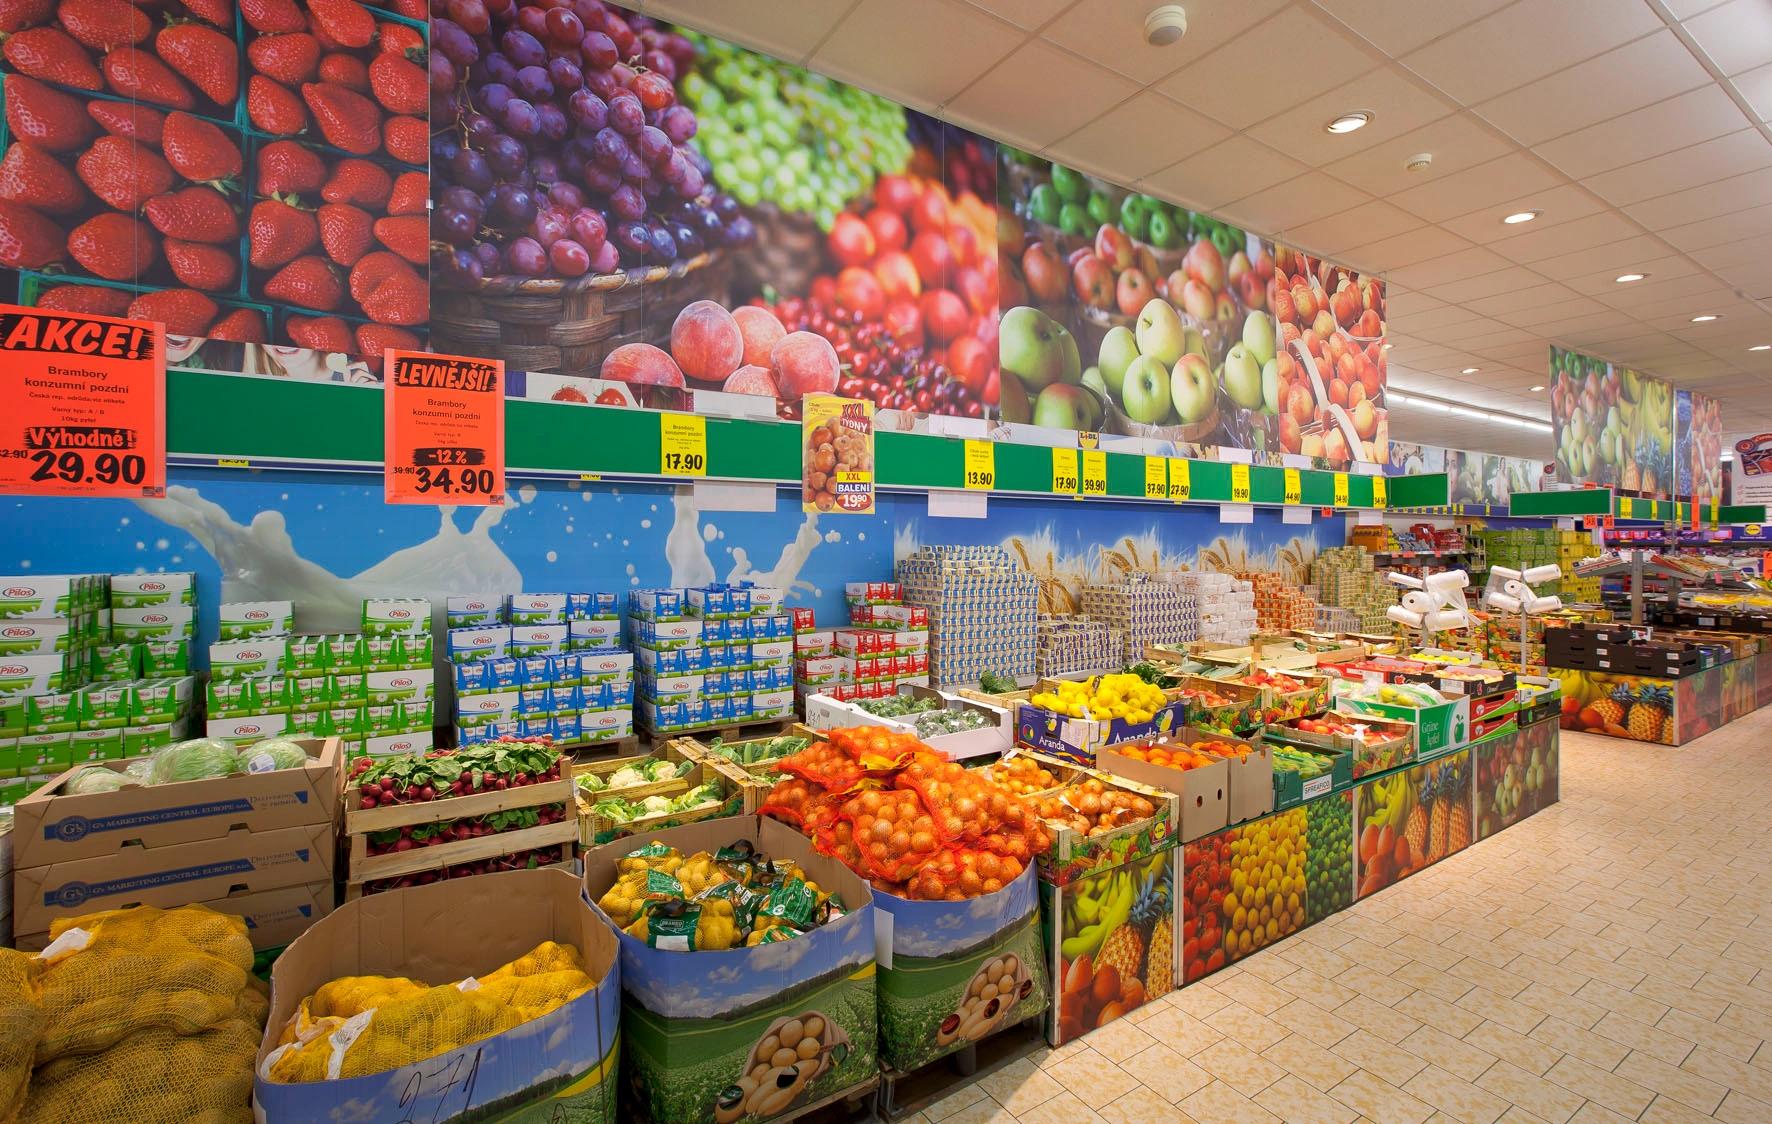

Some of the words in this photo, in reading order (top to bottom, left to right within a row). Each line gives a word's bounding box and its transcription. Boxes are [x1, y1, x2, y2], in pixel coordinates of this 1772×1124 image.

[4, 316, 144, 359] AKCE!
[48, 366, 108, 380] Brambory
[399, 361, 491, 391] LEVNĚJŠÍ!
[25, 378, 86, 390] konzumní
[90, 384, 129, 394] pozdní
[427, 398, 467, 409] Brambory
[412, 408, 452, 418] konzumní
[29, 426, 124, 449] Výhodné
[428, 449, 452, 464] -12
[456, 451, 467, 464] %
[666, 453, 703, 470] 17.90
[30, 450, 146, 485] 29.90
[414, 467, 494, 494] 34.90
[846, 473, 861, 481] XXL
[967, 471, 993, 485] 13.90
[1055, 476, 1077, 489] 17.90
[1084, 479, 1105, 491] 39.90
[1147, 483, 1166, 494] 37.90
[1170, 484, 1189, 496] 27.90
[8, 588, 32, 597] Pilos
[143, 583, 164, 591] Pilos
[146, 615, 166, 623] Pilos
[249, 611, 265, 619] Pilos
[393, 610, 408, 619] Pilos
[7, 628, 32, 637] Pilos
[241, 652, 258, 660] Pilos
[0, 666, 25, 676] Pilos
[394, 679, 410, 687] Pilos
[239, 726, 257, 734] Pilos
[1039, 736, 1066, 751] Aranda
[106, 814, 159, 827] MARKETING
[161, 808, 200, 820] CENTRAL
[201, 804, 236, 814] EUROPE
[107, 877, 159, 890] MARKETING
[161, 870, 201, 881] CENTRAL
[202, 865, 236, 875] EUROPE
